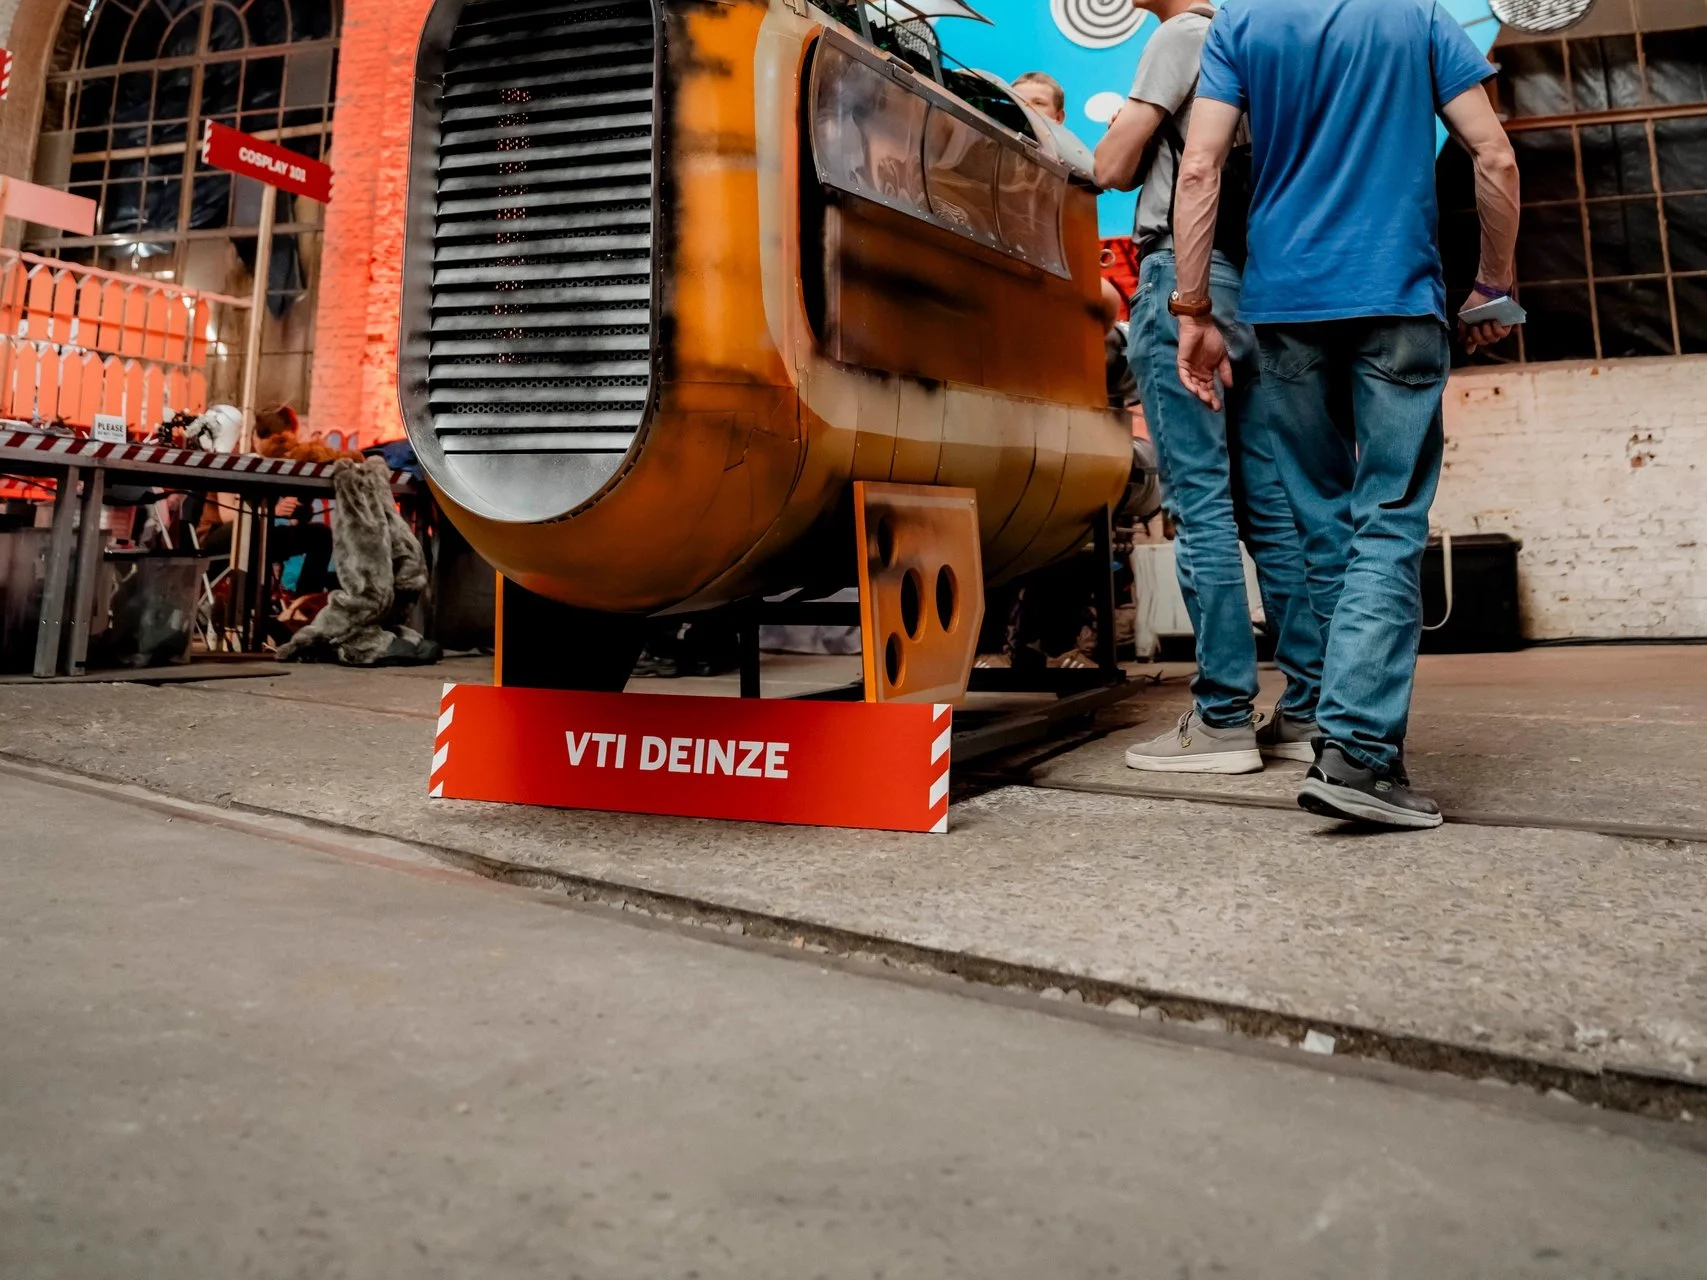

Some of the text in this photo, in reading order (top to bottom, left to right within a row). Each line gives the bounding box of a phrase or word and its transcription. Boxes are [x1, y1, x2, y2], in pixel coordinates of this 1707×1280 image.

[238, 146, 289, 175] COSPLAY
[97, 422, 124, 433] PLEASE
[565, 730, 790, 779] VTI DEINZE
